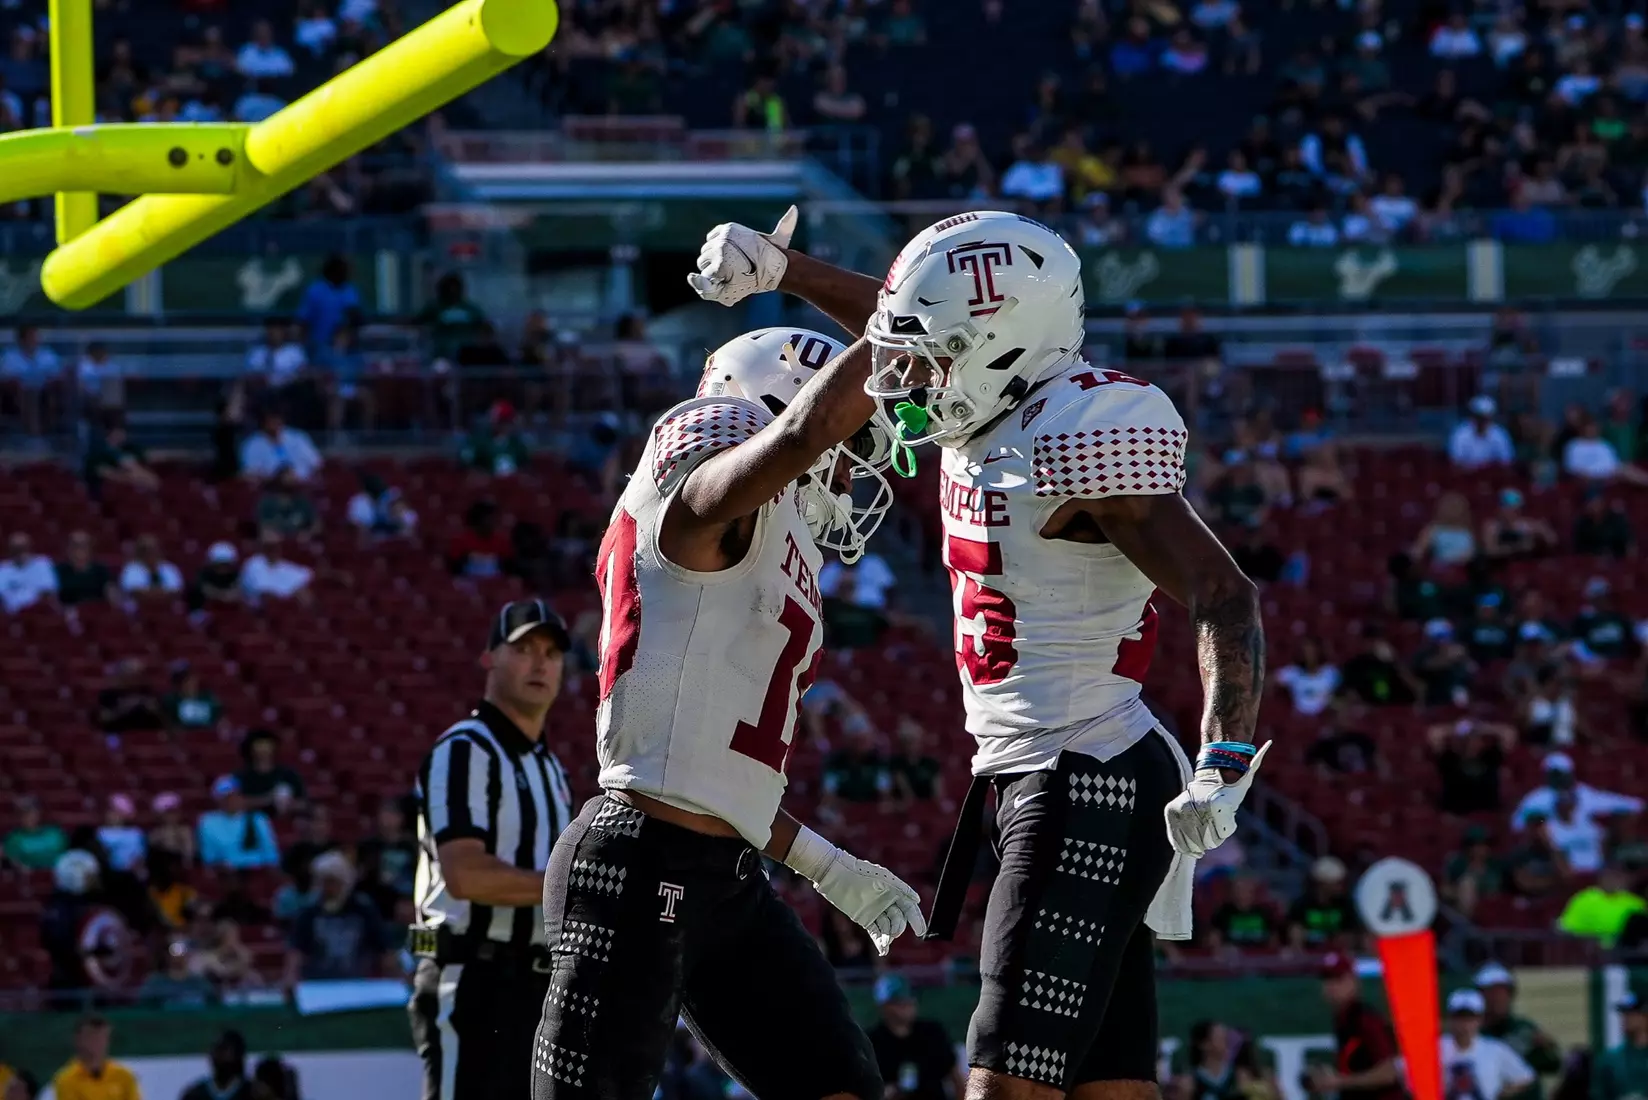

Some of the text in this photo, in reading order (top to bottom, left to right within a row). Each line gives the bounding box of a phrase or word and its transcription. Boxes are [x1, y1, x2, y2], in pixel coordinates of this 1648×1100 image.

[946, 239, 1012, 318] T
[779, 333, 833, 371] 10
[729, 593, 823, 774] 1
[658, 881, 685, 923] T
